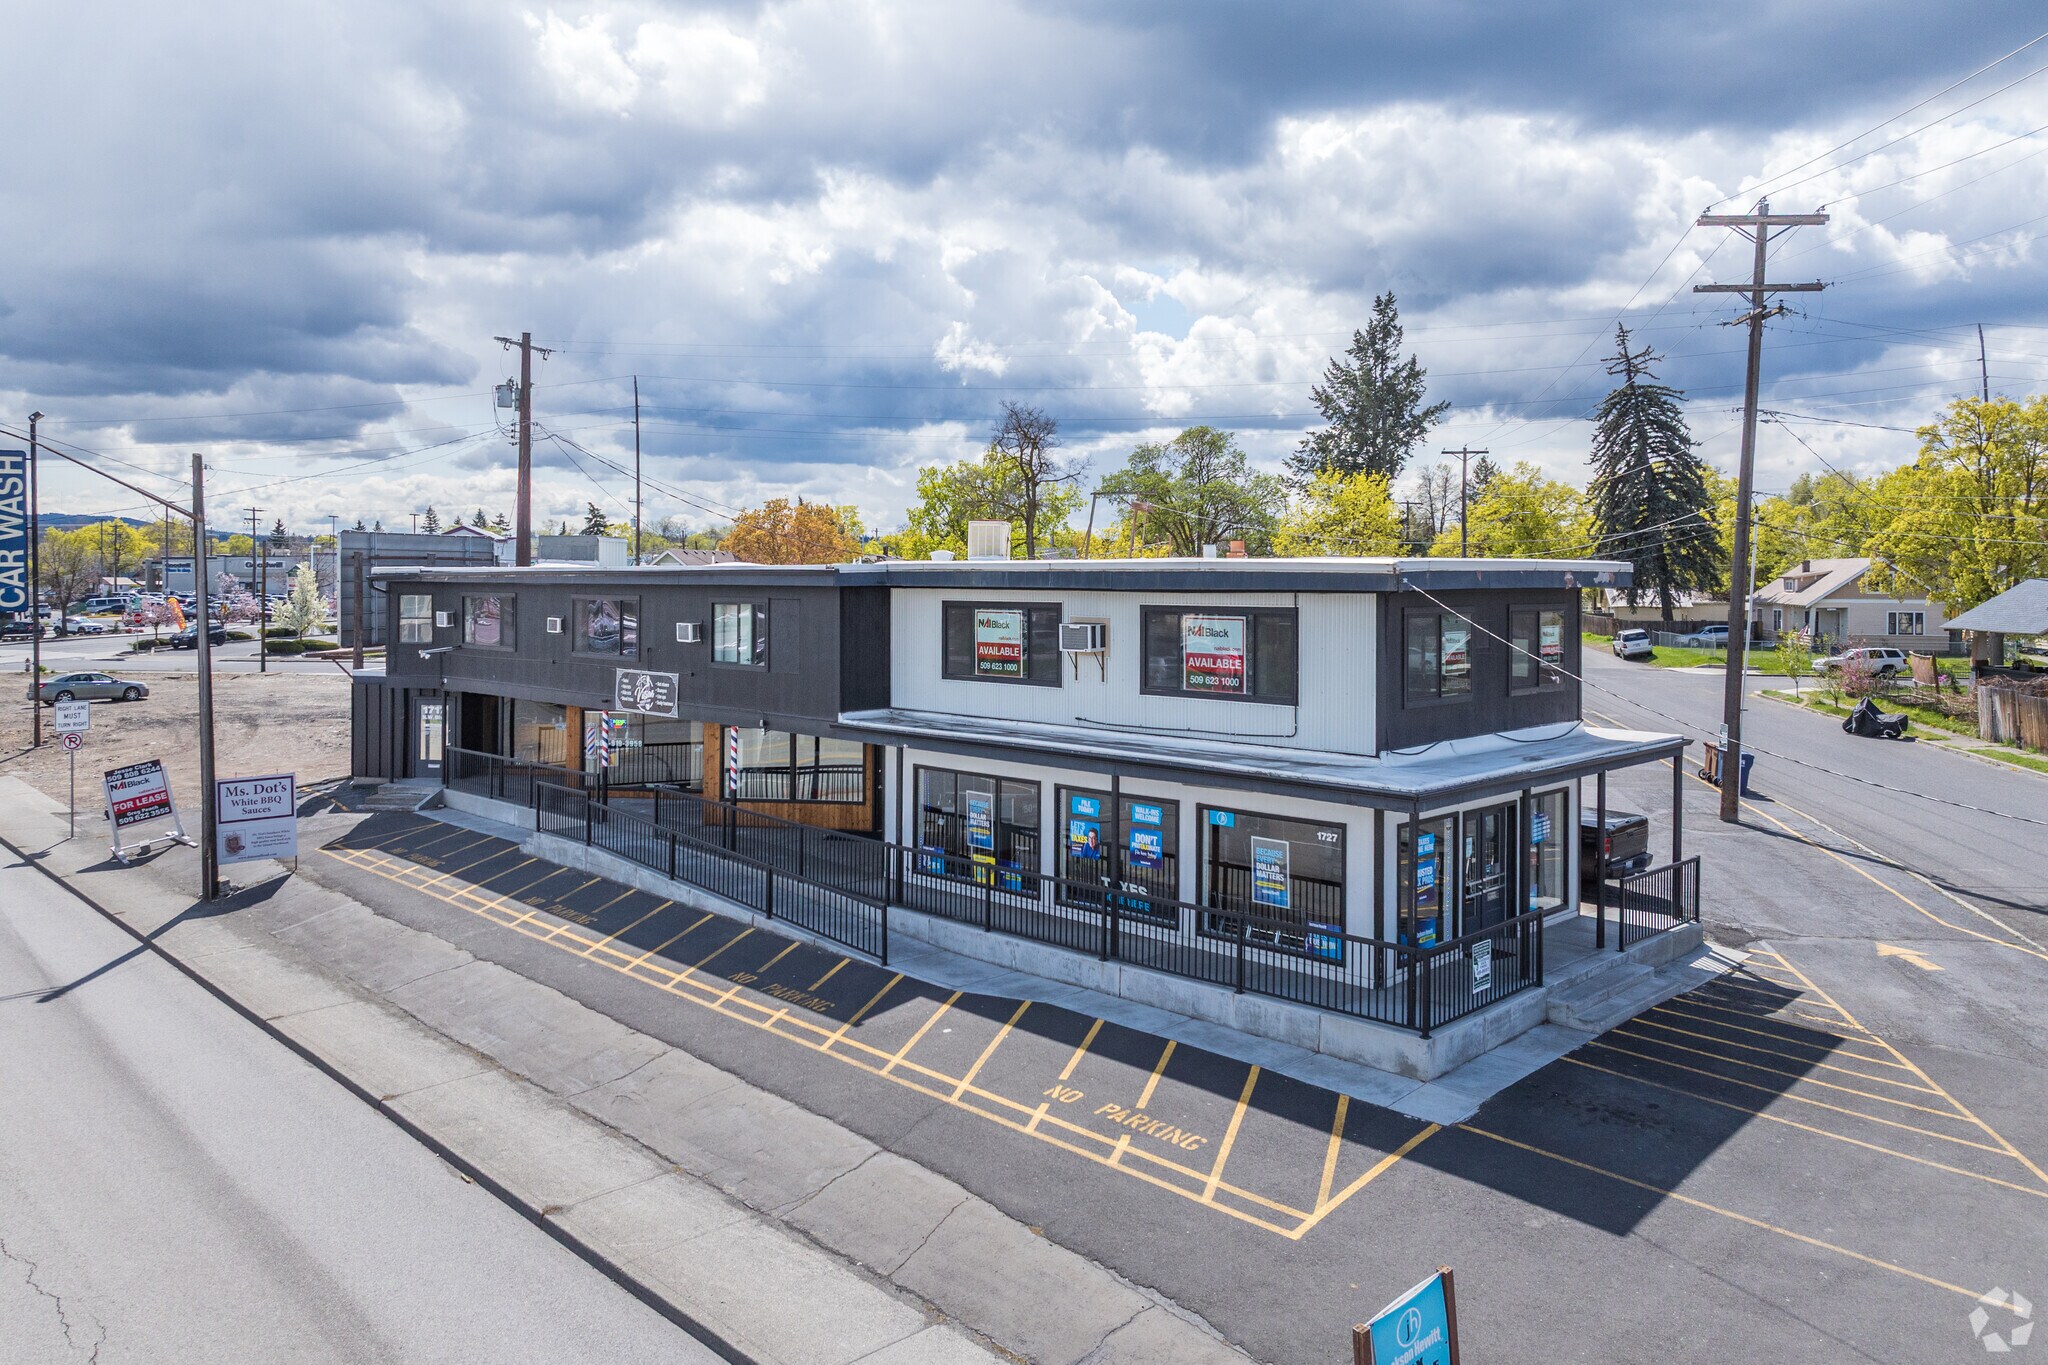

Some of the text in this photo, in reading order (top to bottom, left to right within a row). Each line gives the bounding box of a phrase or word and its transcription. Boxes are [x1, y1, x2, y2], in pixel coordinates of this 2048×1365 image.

[0, 456, 26, 608] CAR WASH
[991, 620, 1010, 629] Black
[1205, 628, 1229, 638] Black
[979, 646, 1020, 657] AVAILABLE
[980, 661, 1018, 671] 509 623 1000
[1188, 657, 1242, 669] AVAILABLE
[1189, 675, 1240, 687] 509 623 1000
[106, 765, 160, 783] 509 808 6244
[127, 777, 151, 787] Black
[225, 781, 287, 798] Ms. Dot's
[113, 792, 167, 812] FOR LEASE
[231, 796, 282, 807] White BBQ
[242, 806, 271, 815] Sauces
[969, 812, 987, 820] DOLLAR
[1135, 806, 1160, 815] WALK-INS
[118, 817, 134, 825] 509
[1134, 812, 1160, 823] WELCOME
[969, 819, 990, 828] MATTERS
[1071, 834, 1088, 843] TAXES
[1134, 832, 1158, 846] DON'T
[1316, 831, 1338, 842] 1727
[1255, 847, 1283, 858] BECAUSE
[1255, 855, 1276, 864] EVERY
[1256, 862, 1280, 873] DOLLAR
[1256, 870, 1285, 882] MATTERS
[1100, 876, 1148, 896] TXES
[544, 904, 598, 925] PARKING
[728, 971, 836, 1012] NO PARKING
[1043, 1084, 1208, 1150] NO PARKING
[1414, 1326, 1441, 1357] Hewitt
